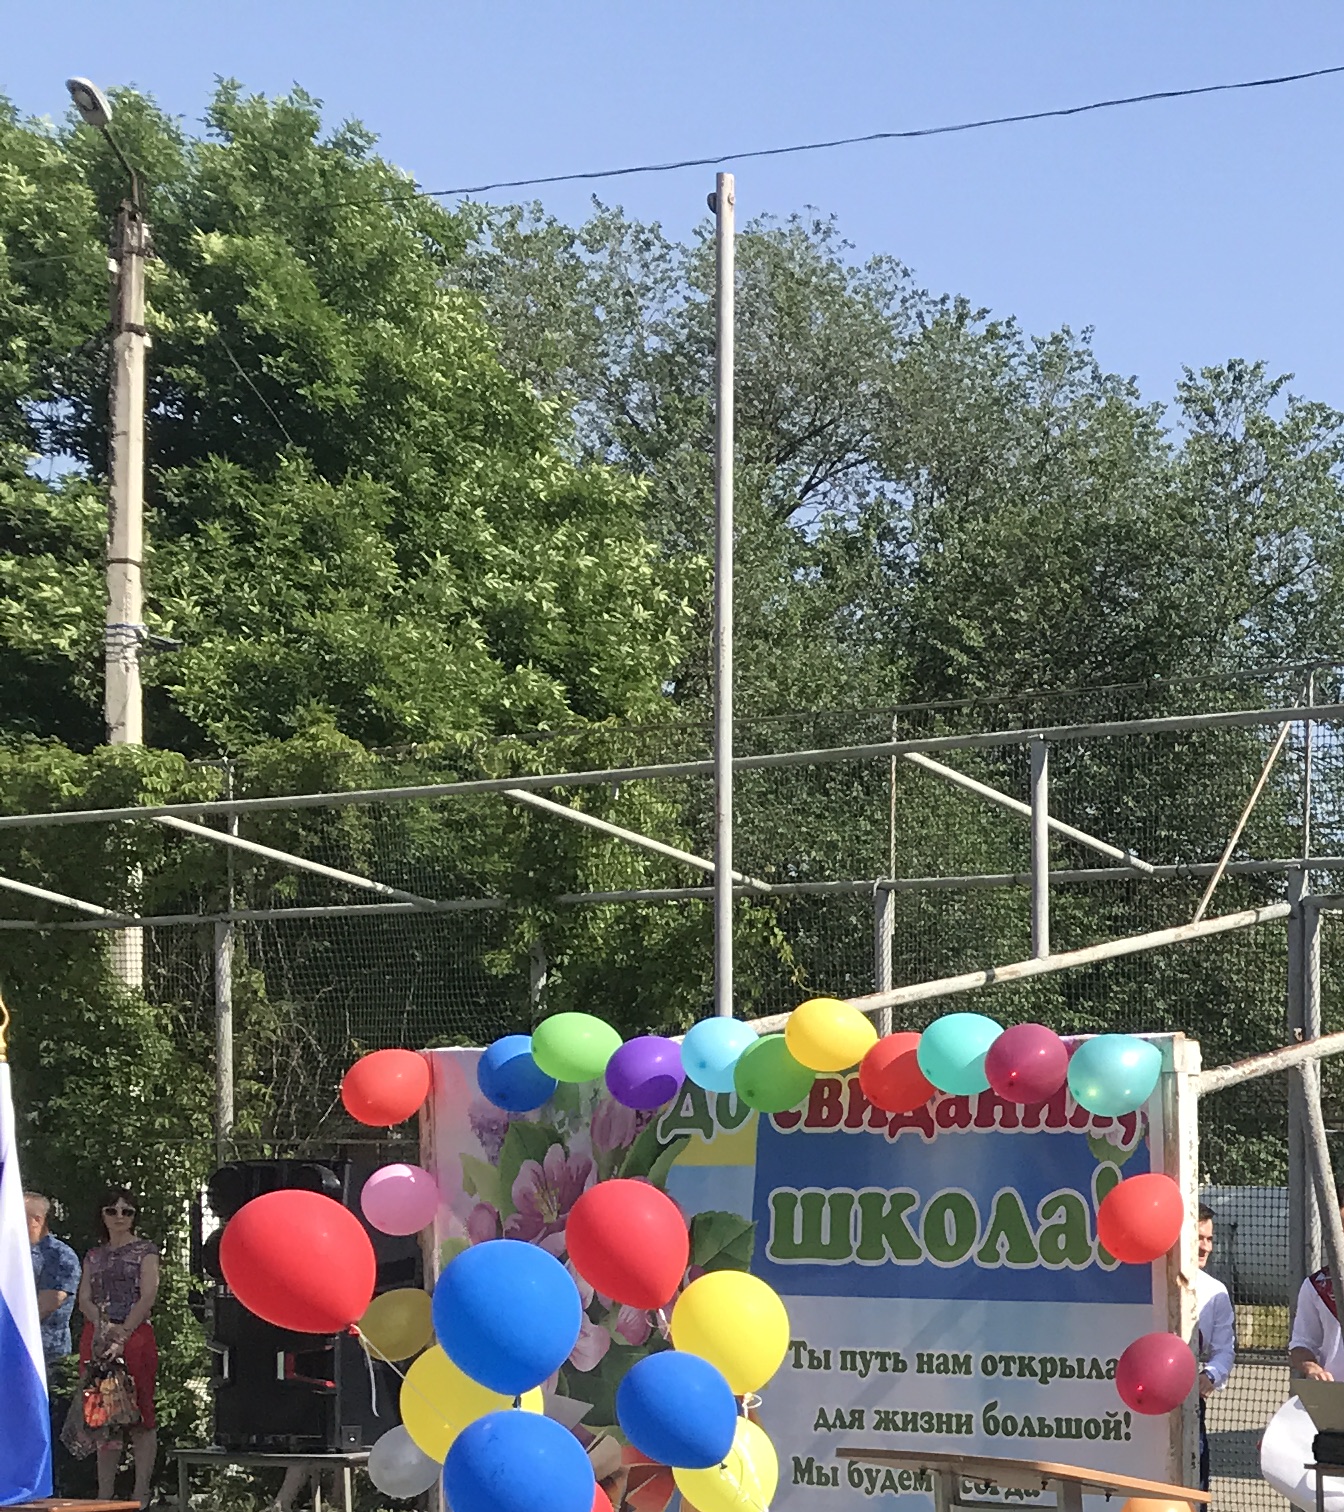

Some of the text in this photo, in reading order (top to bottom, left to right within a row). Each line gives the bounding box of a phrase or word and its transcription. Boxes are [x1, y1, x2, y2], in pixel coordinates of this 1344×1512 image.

[767, 1163, 1123, 1269] школа!
[789, 1341, 1118, 1384] Ты путь нам открыла
[813, 1401, 1132, 1441] для жизни большой!
[792, 1456, 838, 1486] Мы
[847, 1460, 935, 1495] будем
